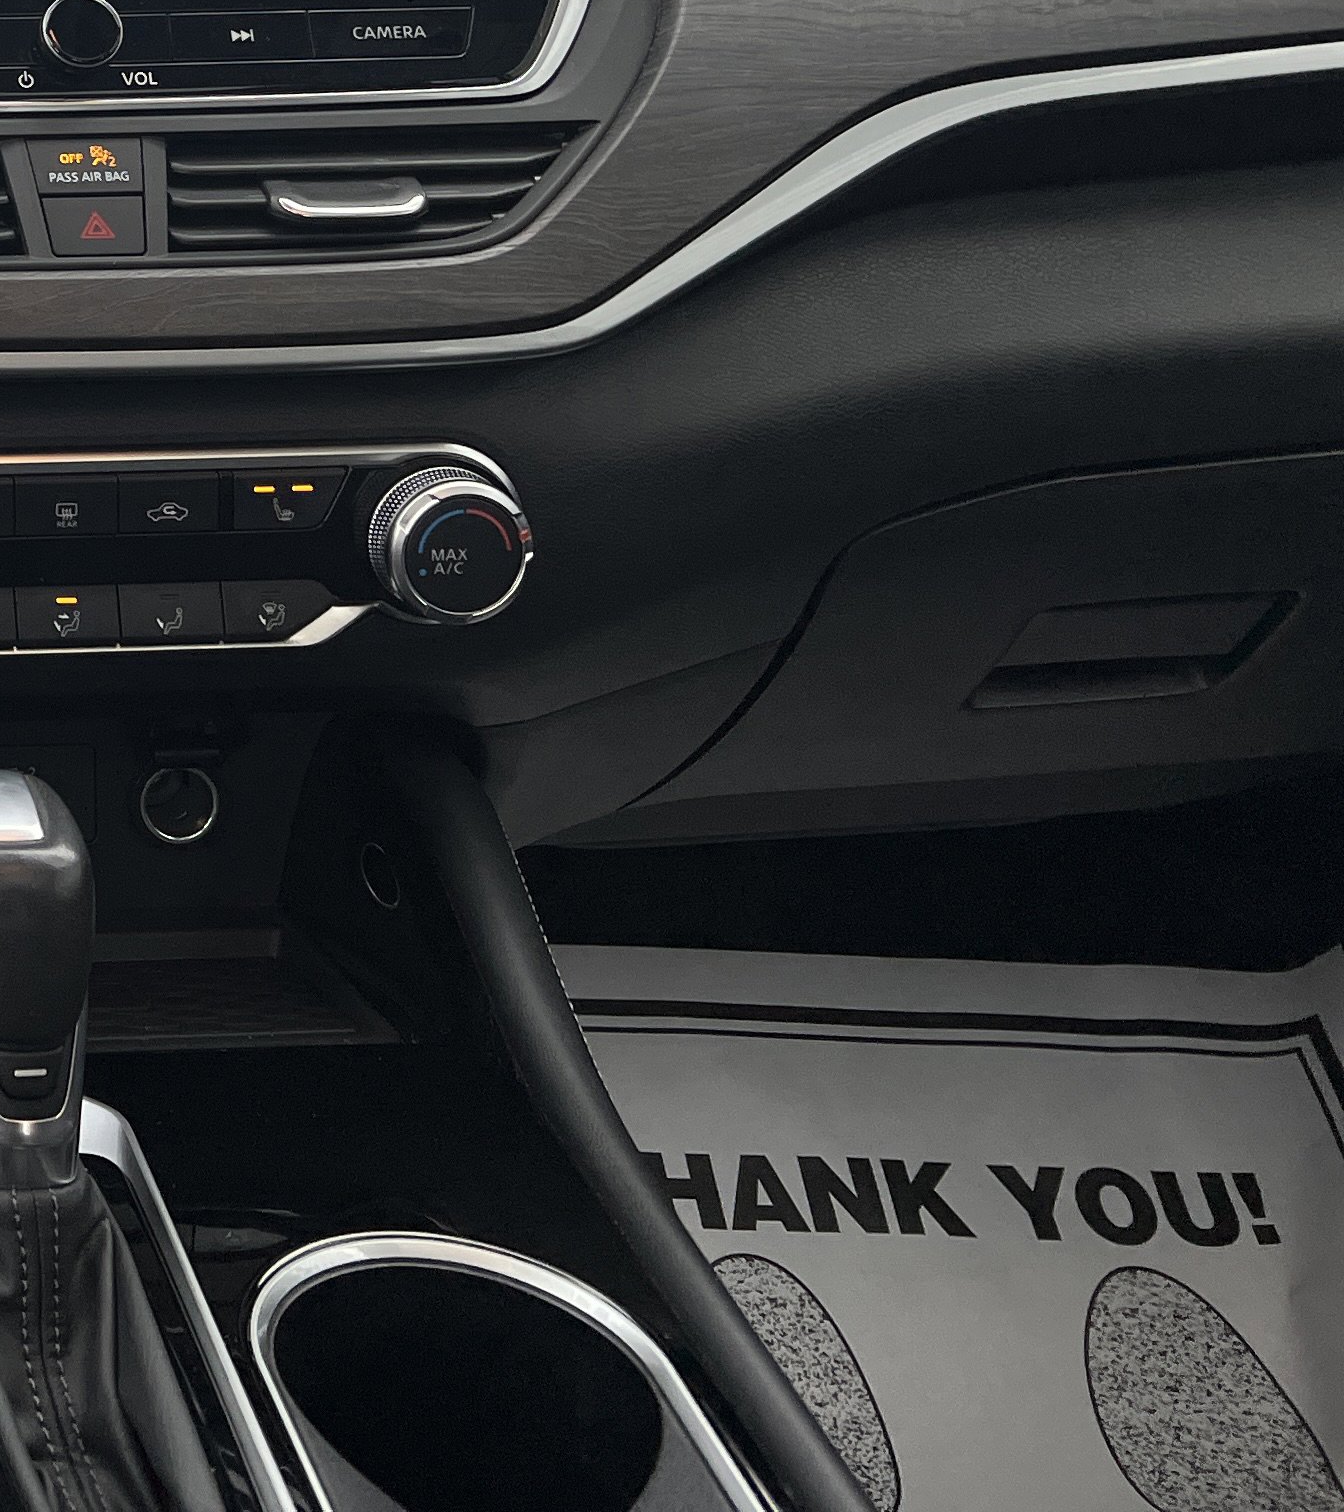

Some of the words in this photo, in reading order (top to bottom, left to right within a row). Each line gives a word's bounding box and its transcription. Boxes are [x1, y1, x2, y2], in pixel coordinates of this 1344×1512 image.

[352, 25, 427, 41] CAMERA
[121, 71, 158, 86] VOL
[59, 153, 84, 164] OFF
[48, 172, 79, 183] PASS
[81, 171, 102, 182] AIR
[104, 170, 130, 182] BAG
[431, 548, 468, 561] MAX
[433, 561, 464, 575] A/C
[635, 1151, 978, 1239] HANK
[986, 1164, 1282, 1248] YOU!
